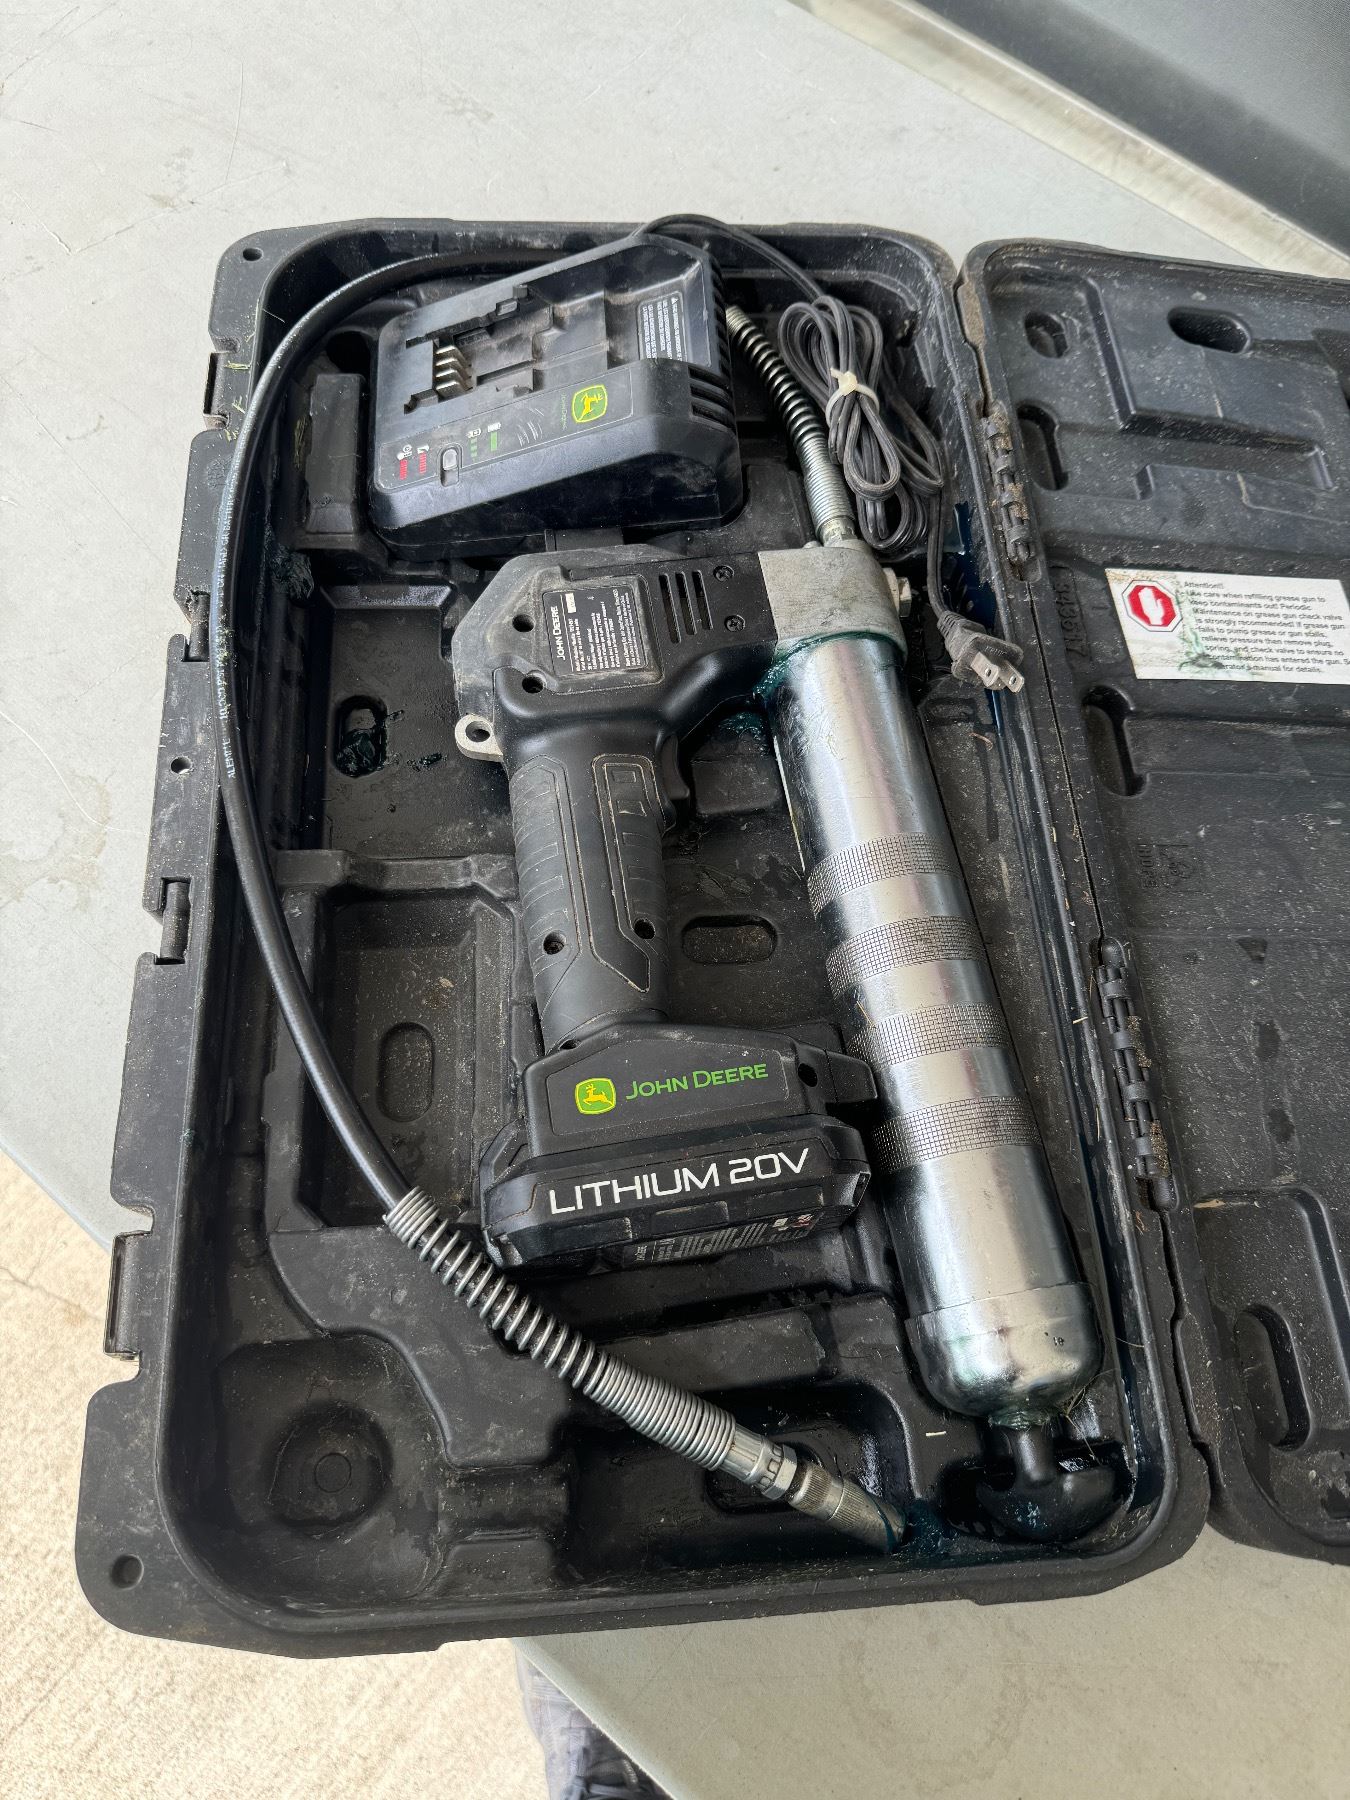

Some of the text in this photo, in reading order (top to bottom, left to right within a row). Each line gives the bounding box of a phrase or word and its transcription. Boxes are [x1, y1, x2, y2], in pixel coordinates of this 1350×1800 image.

[1210, 601, 1262, 609] contaminants
[1280, 603, 1312, 611] Periodic
[1193, 607, 1241, 616] Maintenance
[1204, 618, 1236, 627] strongly
[550, 605, 566, 661] JOHN DEERE
[1229, 637, 1264, 645] pressure
[1281, 656, 1310, 664] entered
[626, 1063, 769, 1100] JOHN DEERE
[550, 1148, 809, 1214] LITHIUM 20V
